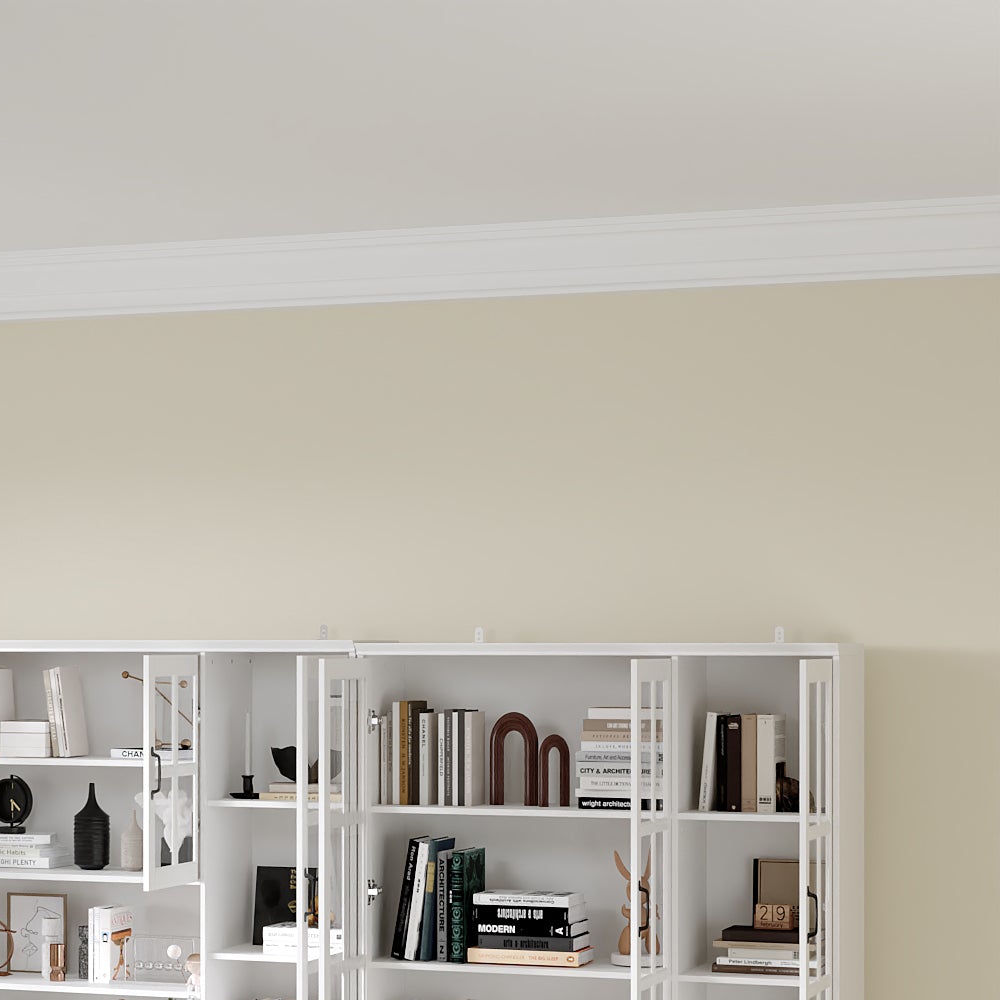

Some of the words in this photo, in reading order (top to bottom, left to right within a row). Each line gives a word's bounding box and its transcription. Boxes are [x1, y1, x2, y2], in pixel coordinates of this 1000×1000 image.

[581, 800, 602, 808] wright
[7, 848, 26, 856] Habits
[497, 908, 526, 920] architecture
[533, 909, 543, 920] arts
[478, 924, 516, 933] MODERN
[555, 927, 563, 935] A
[520, 940, 549, 949] architecture
